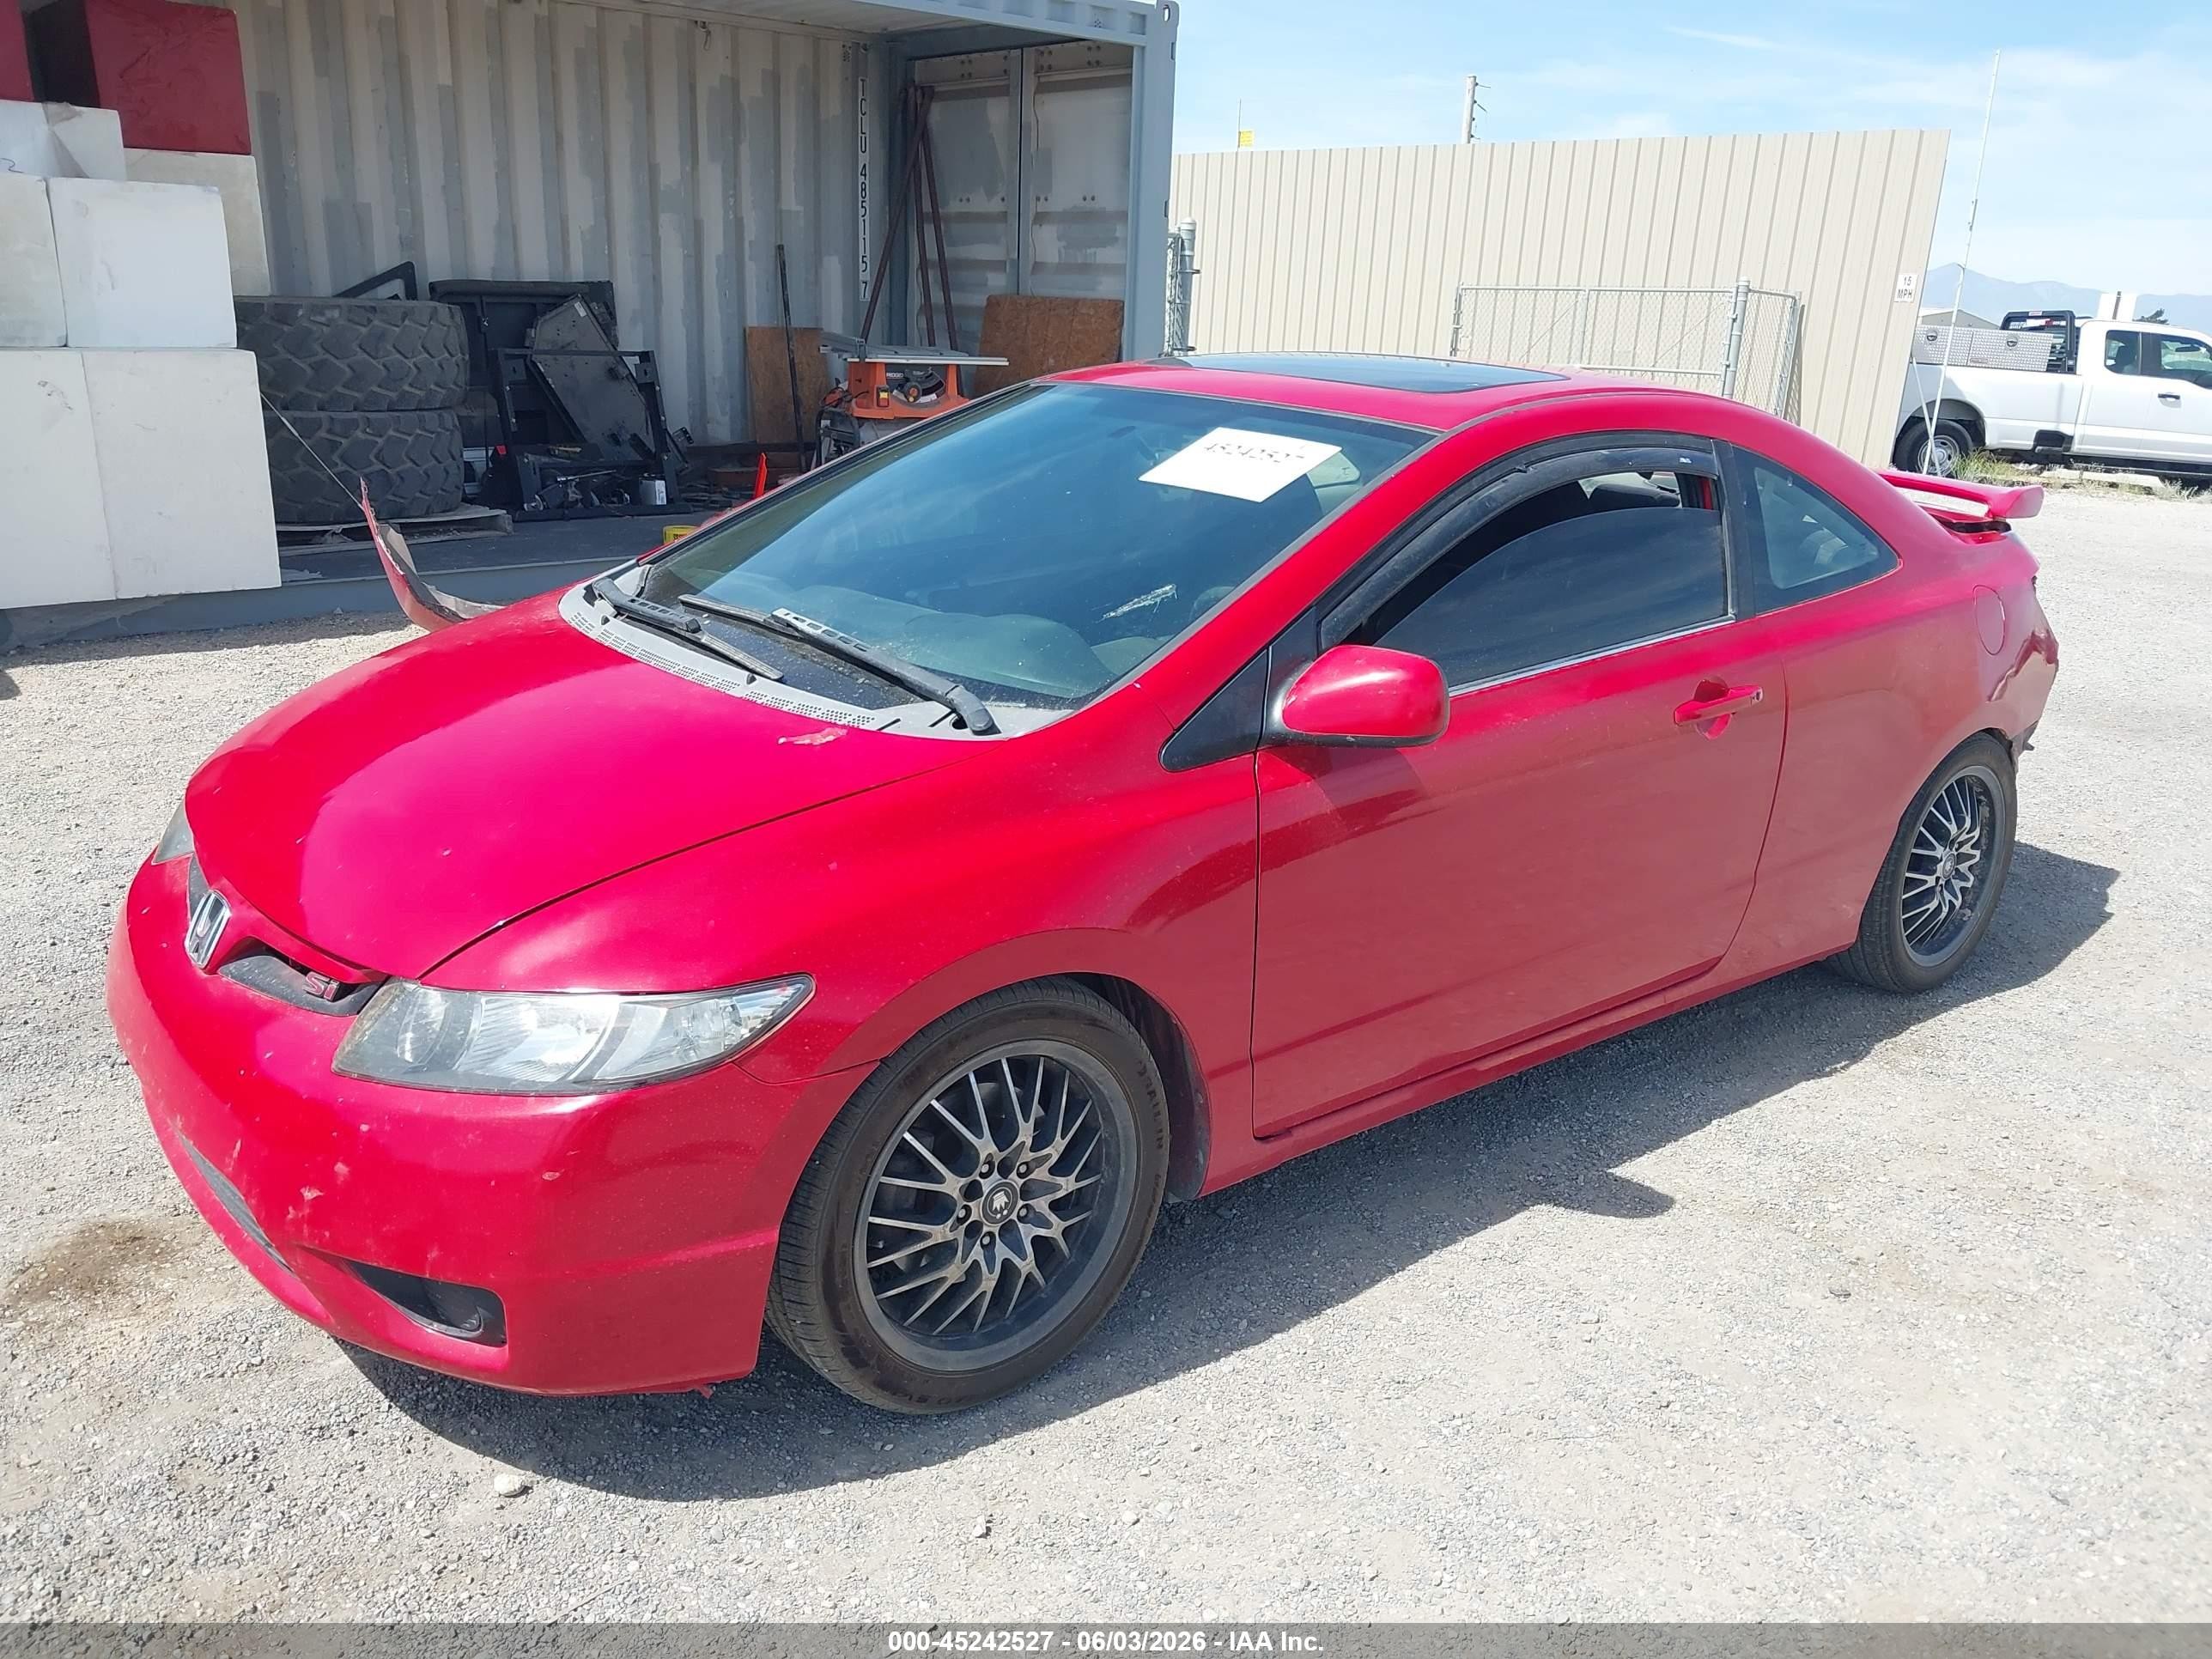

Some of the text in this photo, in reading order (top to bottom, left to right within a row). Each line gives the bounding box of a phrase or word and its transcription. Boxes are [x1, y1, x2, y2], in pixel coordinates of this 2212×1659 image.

[860, 162, 868, 273] 485115
[861, 281, 868, 299] 7
[1903, 276, 1912, 286] 15
[1897, 289, 1913, 299] MPH
[302, 971, 340, 1002] Si
